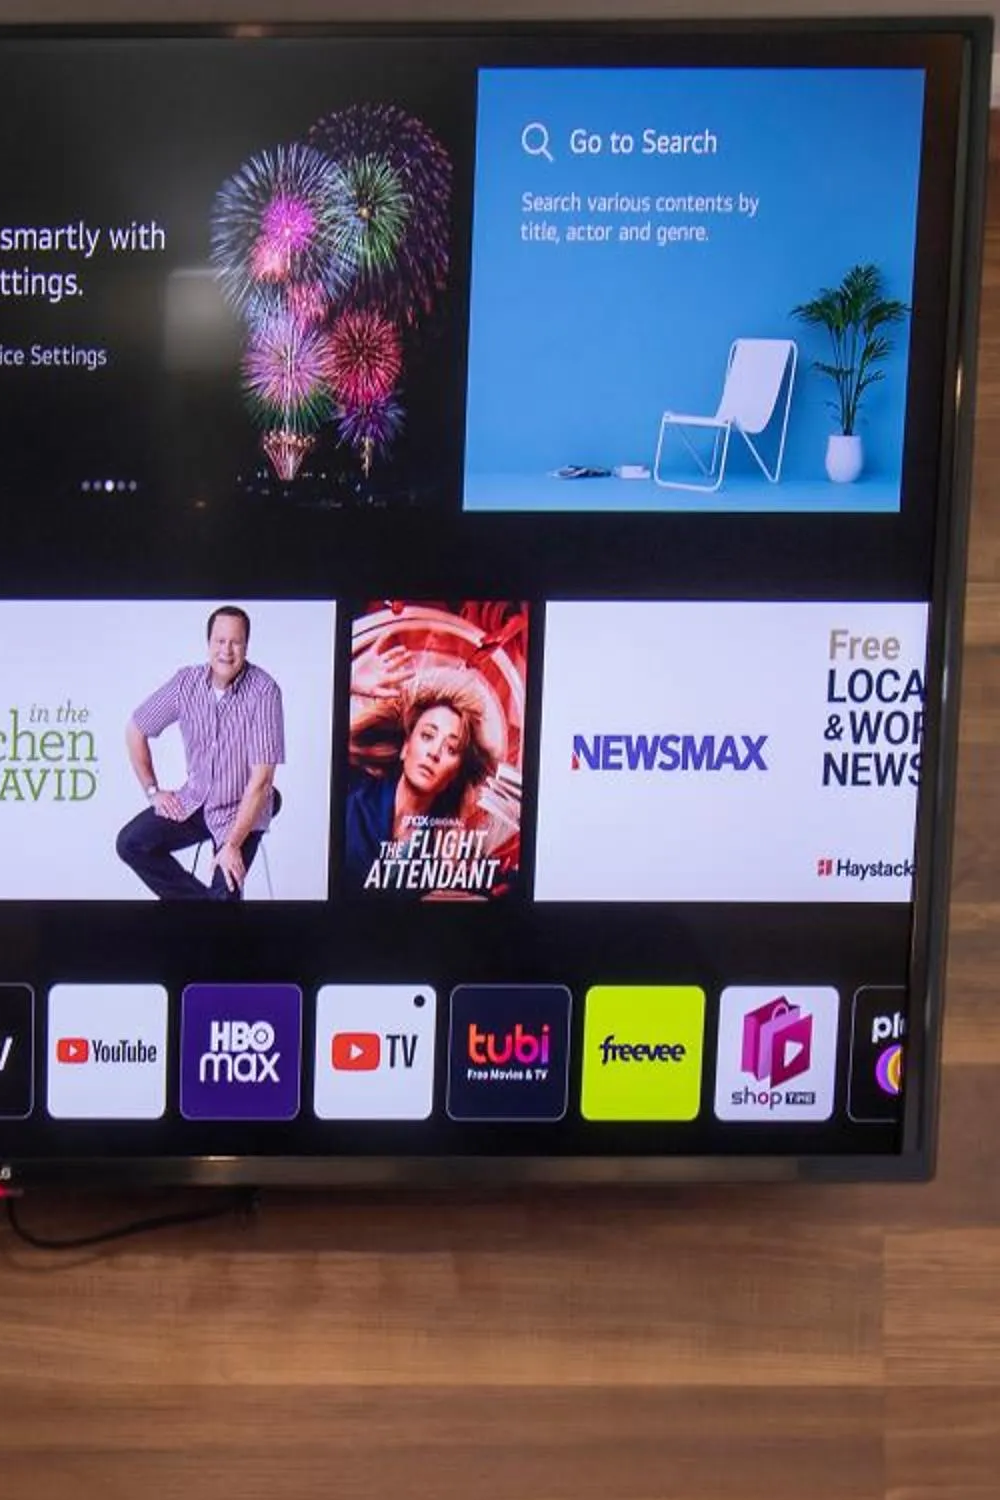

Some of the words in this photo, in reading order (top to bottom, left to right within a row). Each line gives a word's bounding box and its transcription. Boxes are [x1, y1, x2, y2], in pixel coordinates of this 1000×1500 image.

[570, 130, 602, 154] Go
[610, 132, 633, 154] to
[641, 128, 718, 154] Search
[522, 192, 581, 212] Search
[587, 193, 651, 212] various
[656, 194, 733, 212] contents
[738, 192, 760, 217] by
[0, 221, 100, 258] smartly
[109, 220, 166, 250] with
[520, 222, 560, 244] title,
[566, 225, 610, 242] actor
[619, 222, 651, 242] and
[657, 226, 709, 246] genre.
[31, 345, 107, 371] Settings
[829, 629, 901, 660] Free
[29, 704, 49, 723] in
[56, 699, 90, 723] the
[823, 714, 844, 741] &
[571, 735, 768, 770] NEWSMAX
[379, 842, 405, 859] THE
[408, 829, 489, 859] FLIGHT
[363, 859, 501, 889] ATTENDANT
[836, 859, 914, 880] Haystack
[210, 1020, 275, 1052] HBO
[468, 1023, 550, 1065] tubi
[598, 1034, 686, 1066] freevee
[91, 1039, 157, 1064] YouTube
[386, 1033, 418, 1069] TV
[199, 1052, 280, 1084] max
[467, 1068, 489, 1080] Free
[490, 1068, 524, 1080] Movies
[534, 1068, 549, 1080] TV
[731, 1085, 783, 1110] shop
